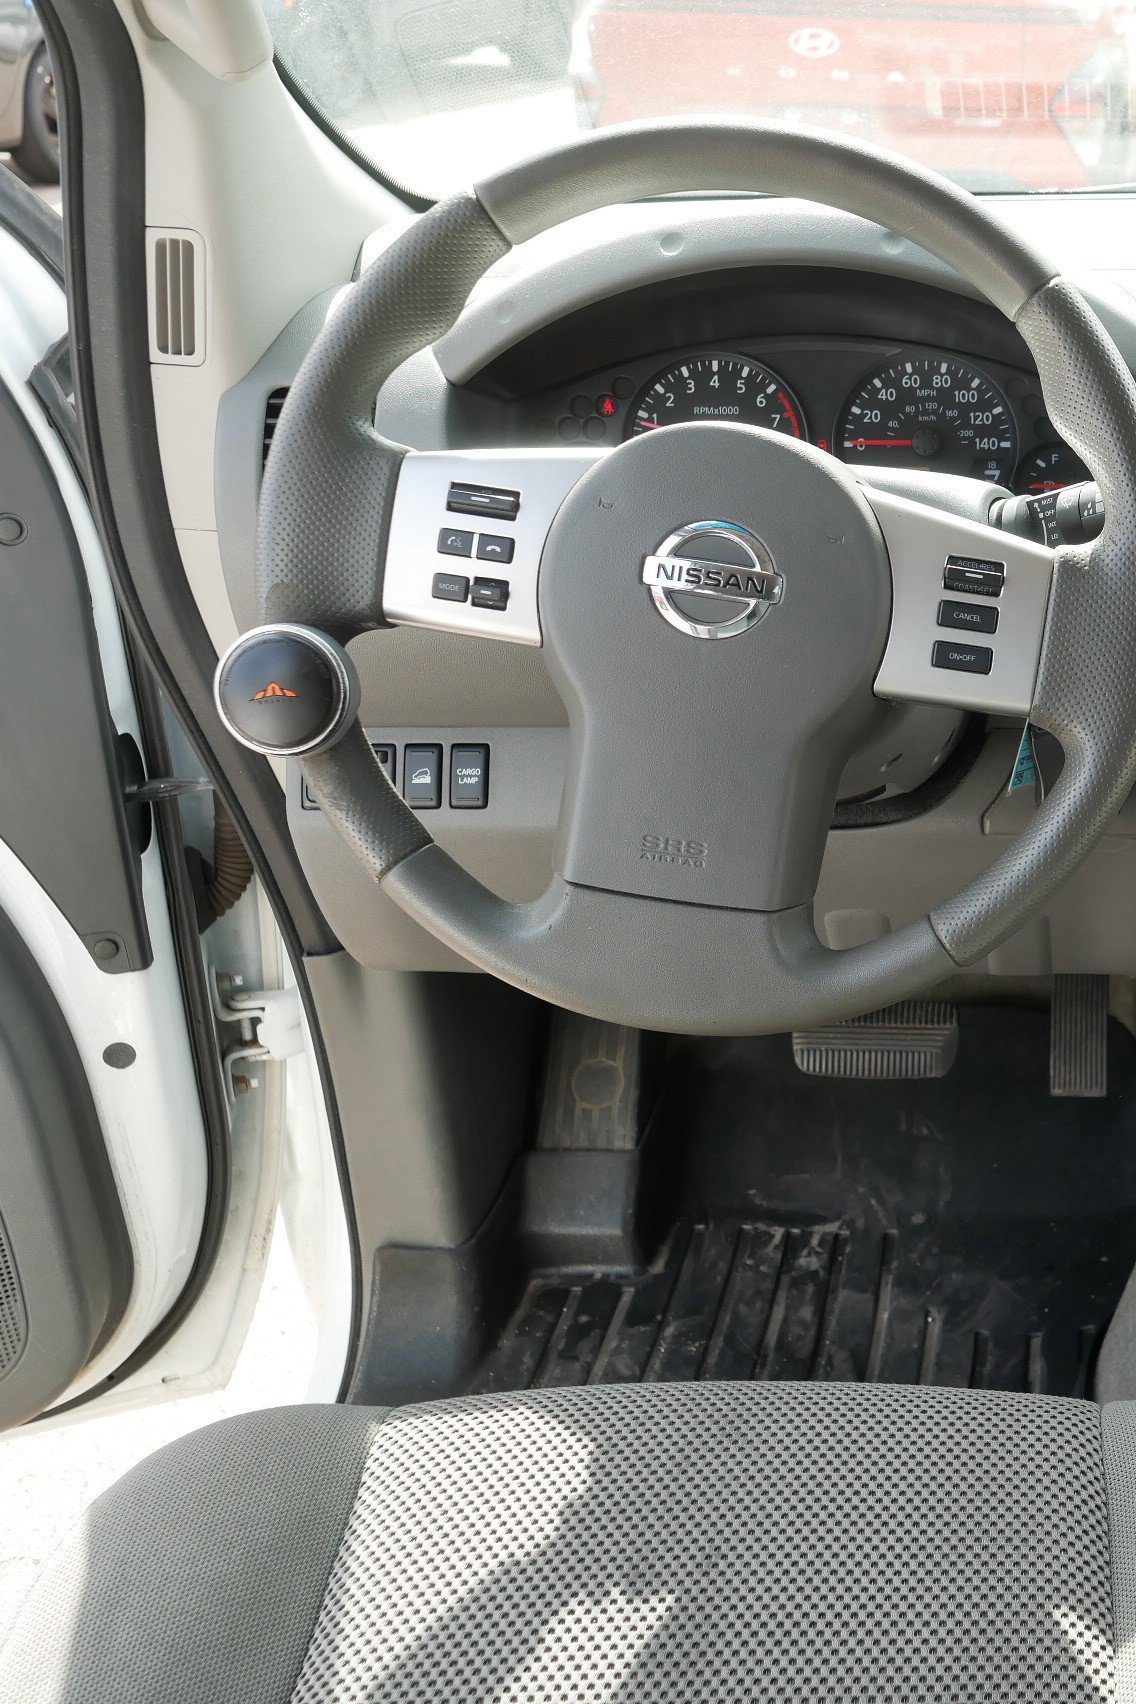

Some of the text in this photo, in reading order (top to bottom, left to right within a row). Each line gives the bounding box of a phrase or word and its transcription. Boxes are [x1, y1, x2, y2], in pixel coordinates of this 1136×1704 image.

[686, 380, 695, 393] 3
[710, 375, 720, 388] 4
[737, 380, 746, 393] 5
[902, 375, 920, 388] 60
[932, 375, 950, 388] 80
[878, 389, 896, 401] 40
[916, 389, 937, 397] MPH
[954, 390, 978, 402] 100
[666, 393, 674, 407] 2
[756, 394, 766, 407] 6
[694, 406, 739, 415] RPMx1000
[863, 410, 881, 423] 20
[652, 413, 657, 425] 1
[771, 415, 781, 428] 7
[888, 420, 898, 428] 40
[969, 412, 992, 424] 120
[975, 438, 998, 450] 140
[1051, 454, 1059, 464] F
[1041, 497, 1054, 505] MIST
[1045, 510, 1056, 518] OFF
[656, 563, 767, 595] NISSAN
[438, 582, 460, 592] MODE
[953, 611, 981, 622] CANCEL
[456, 768, 481, 776] CARGO
[642, 834, 707, 856] SRS
